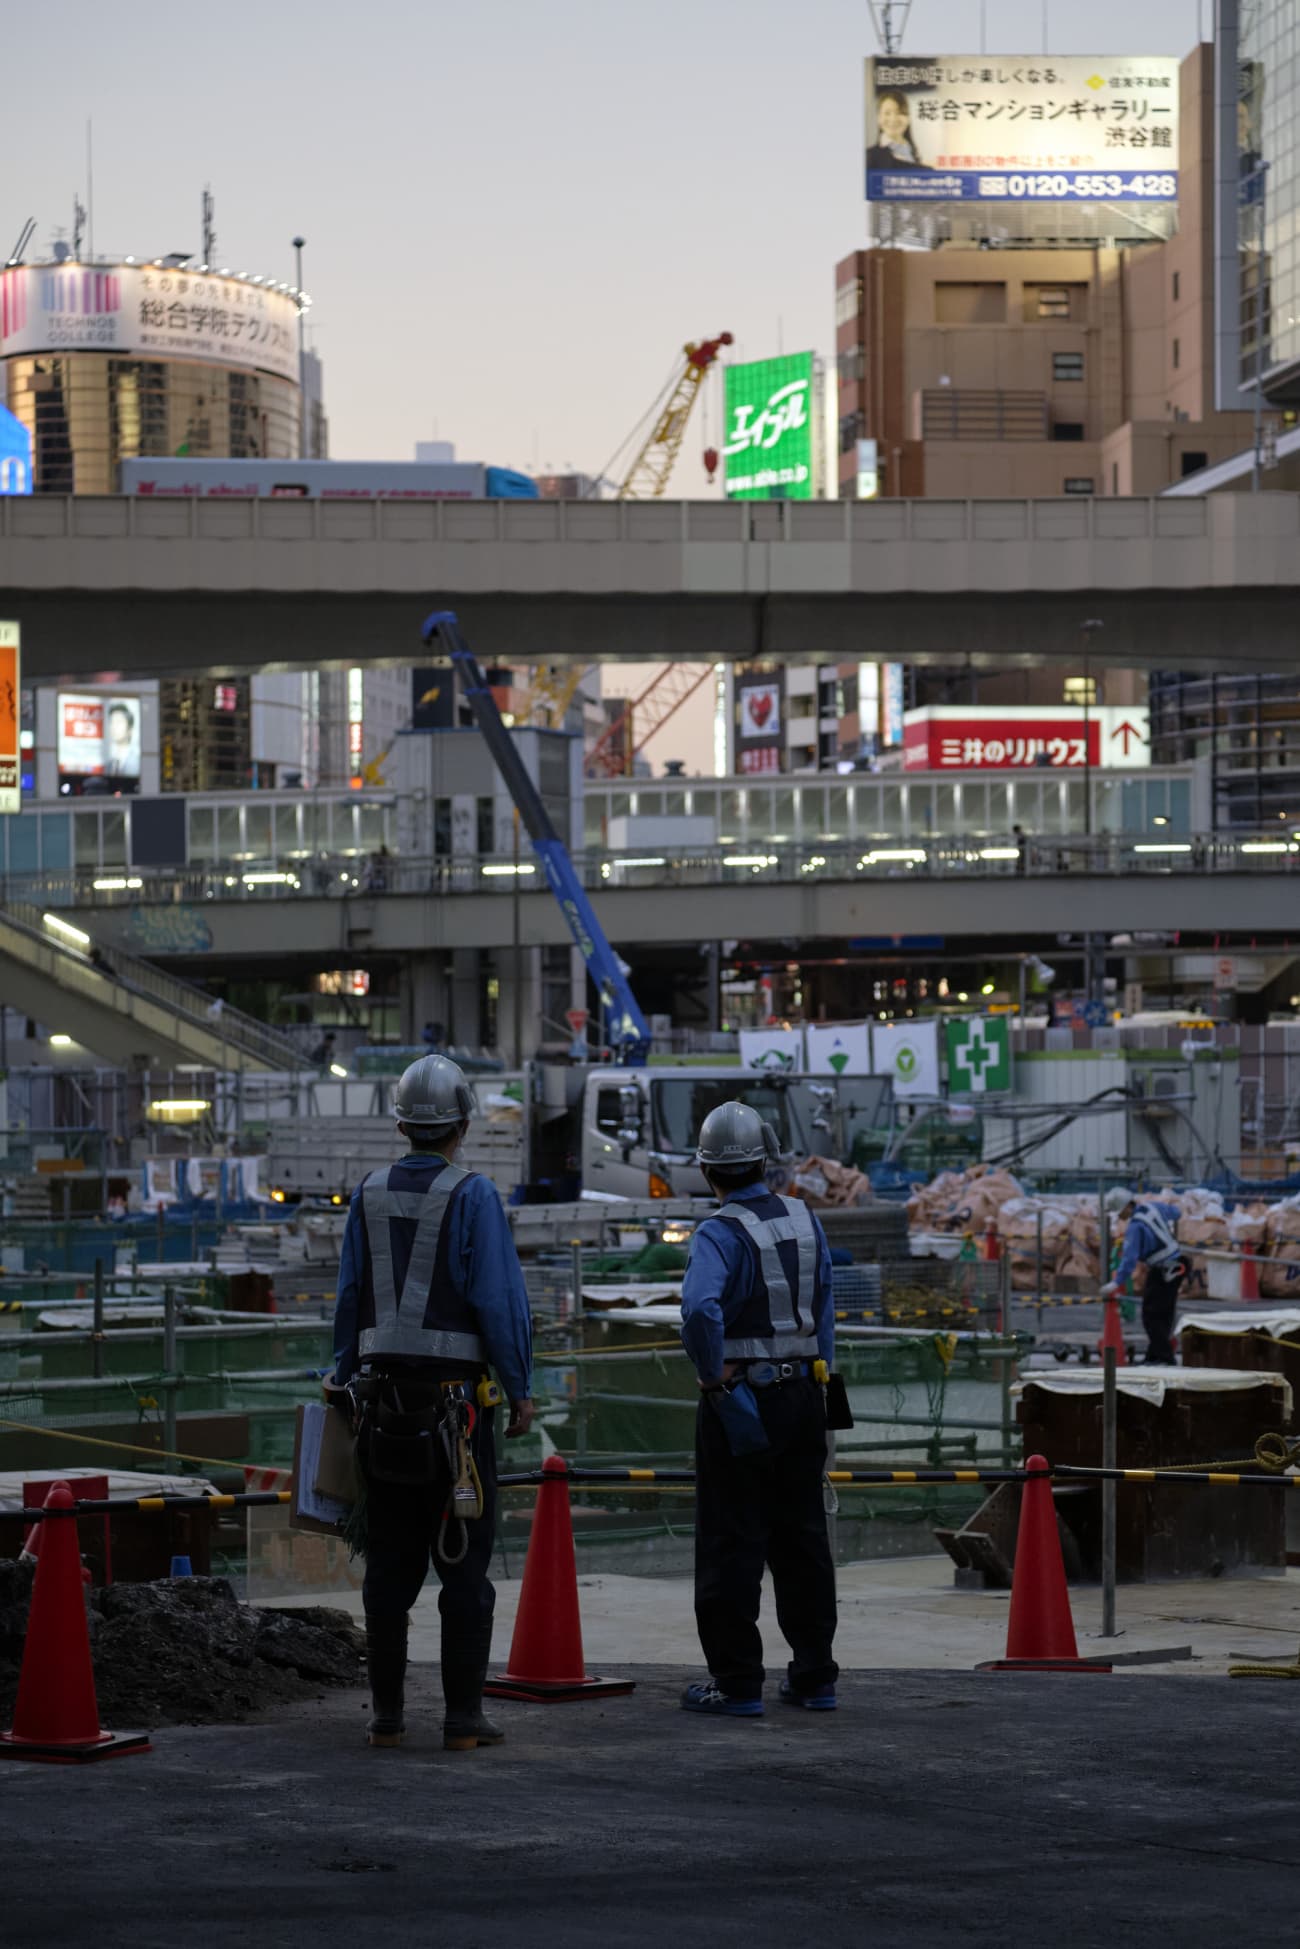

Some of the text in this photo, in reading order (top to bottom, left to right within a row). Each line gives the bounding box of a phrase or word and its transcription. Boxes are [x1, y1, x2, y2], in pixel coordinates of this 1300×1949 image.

[917, 99, 1172, 121] 総合マンションギャラリー
[1105, 126, 1173, 148] 渋谷館
[1008, 175, 1177, 197] 0120-553-428
[47, 316, 116, 329] TECHNOS
[47, 330, 116, 343] COLLEGE
[940, 737, 1087, 764] 三井のリハウス
